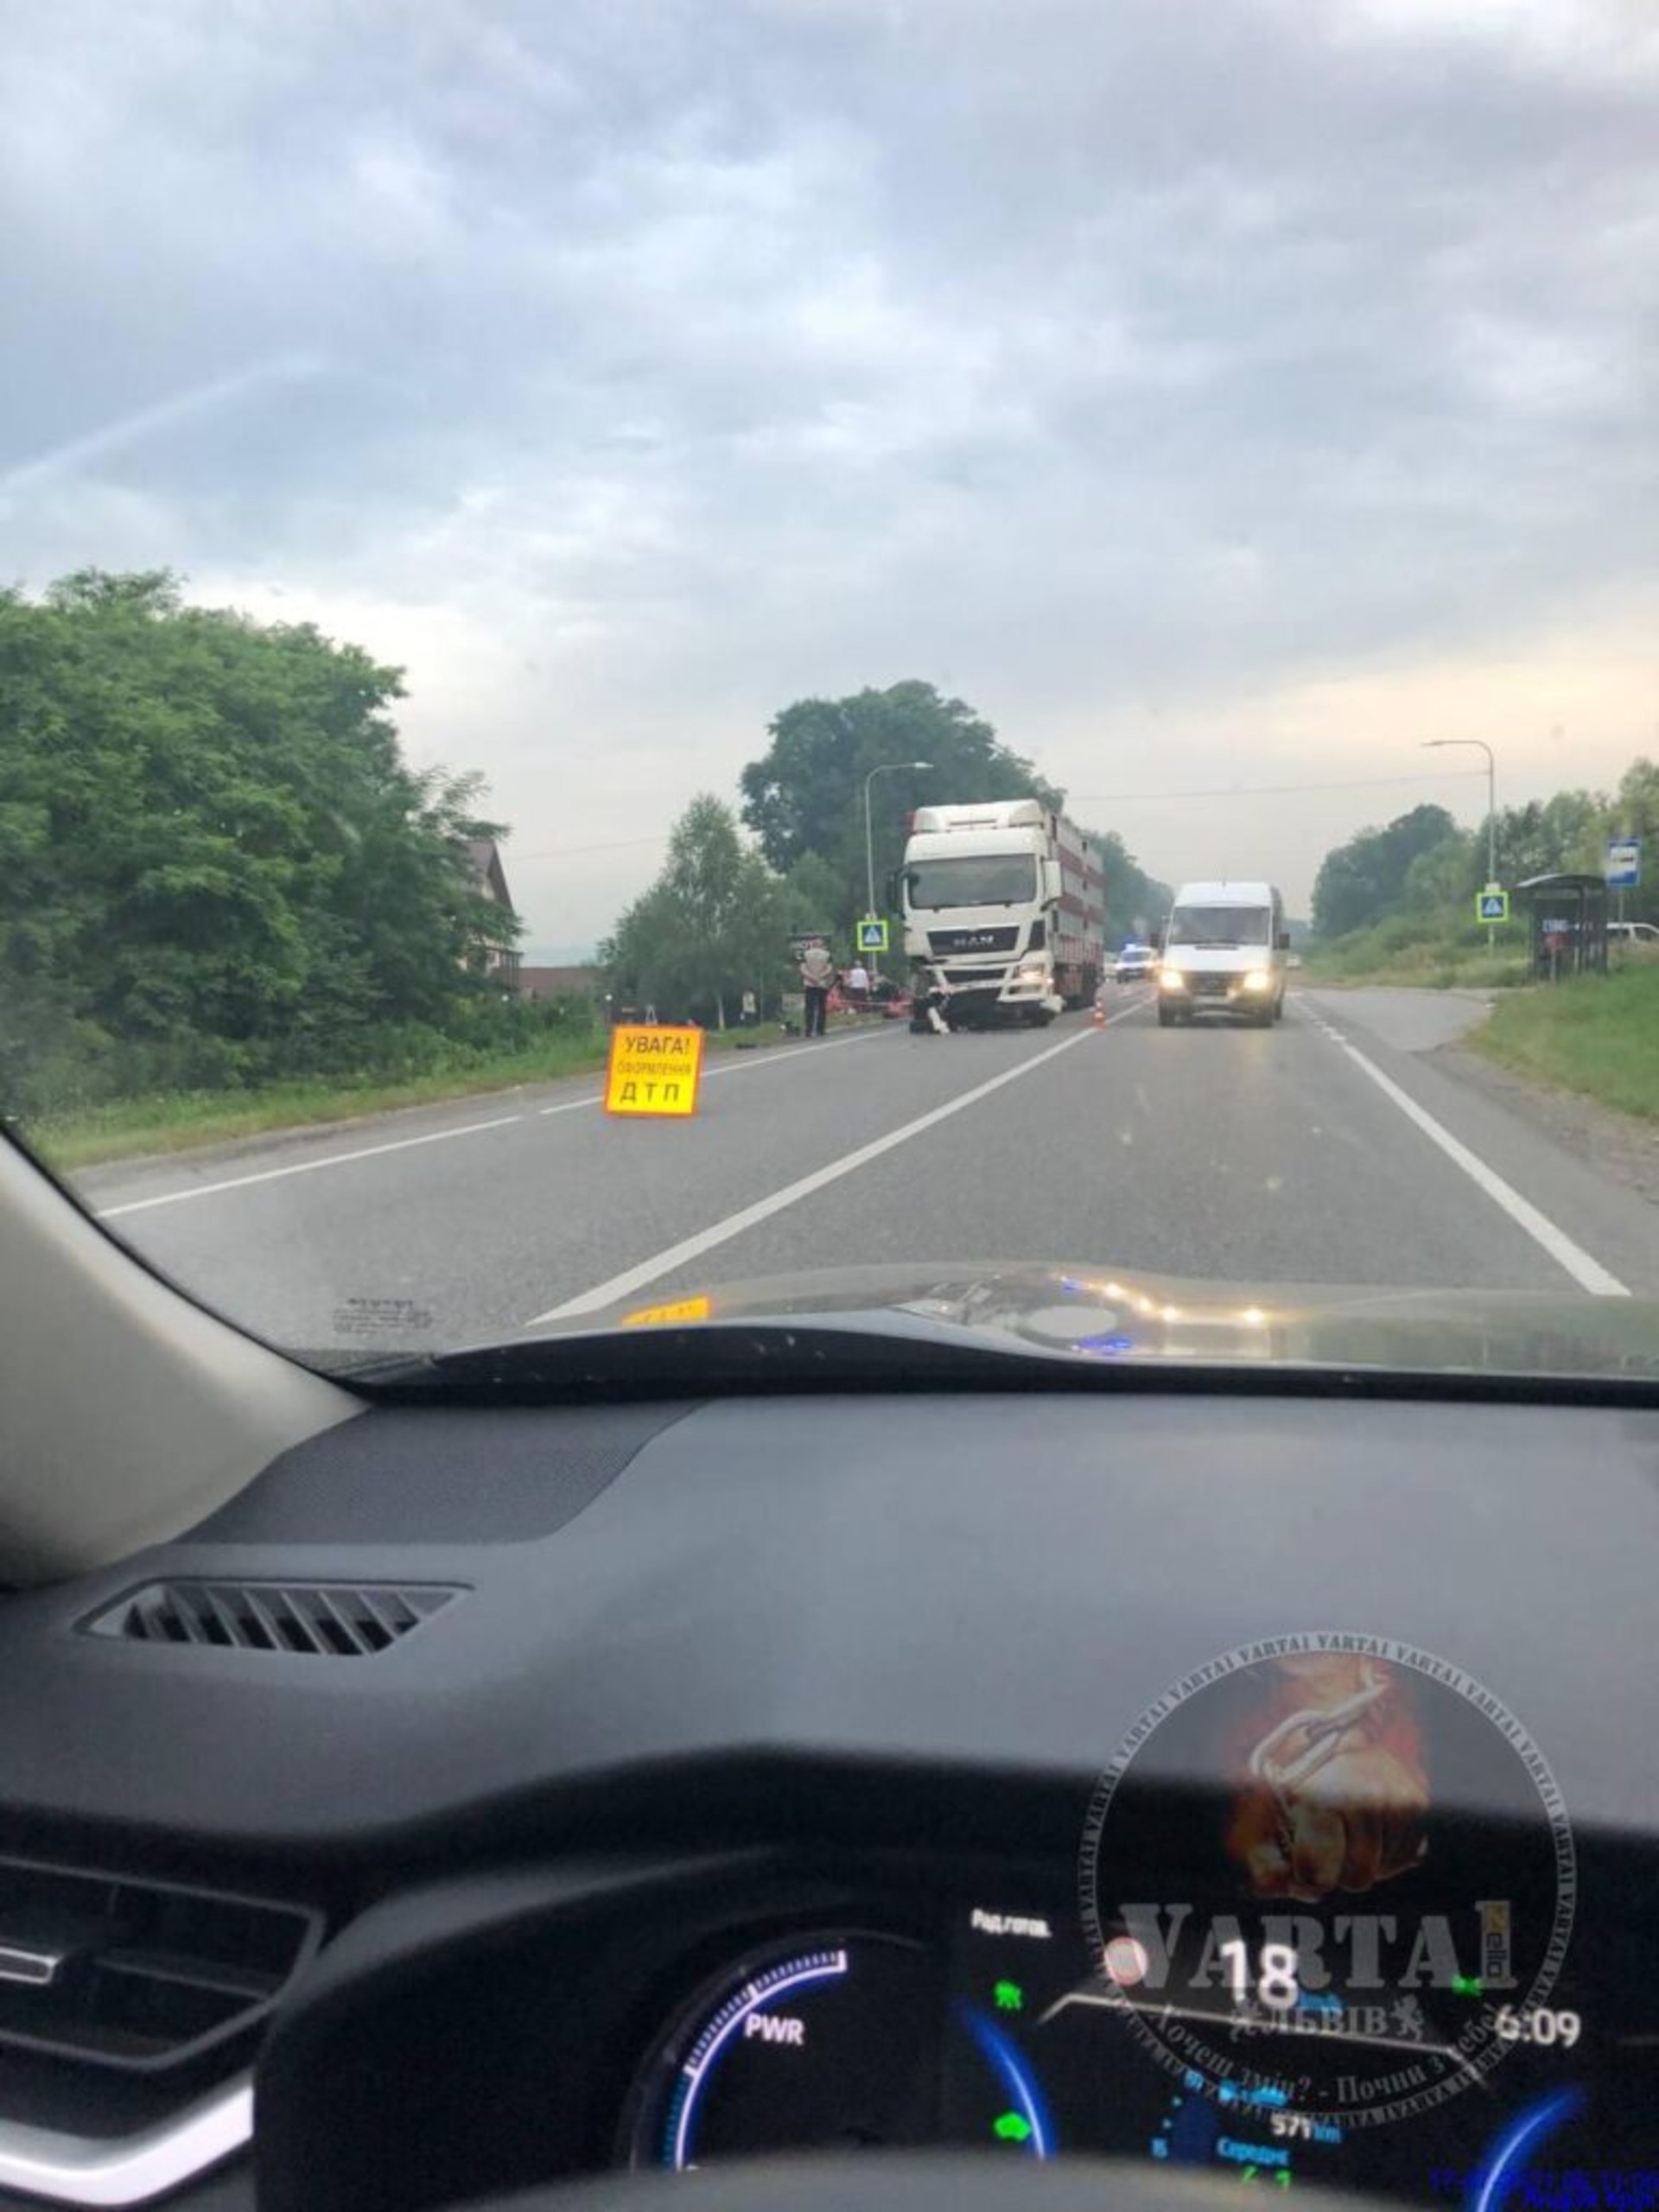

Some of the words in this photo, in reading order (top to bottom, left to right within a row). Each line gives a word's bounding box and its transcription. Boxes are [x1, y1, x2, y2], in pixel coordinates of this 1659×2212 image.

[626, 1036, 690, 1055] УВАГА!
[1220, 1940, 1300, 2010] 18
[744, 2012, 806, 2047] PWR
[1495, 2004, 1582, 2047] 6:09
[1269, 2113, 1312, 2140] 571
